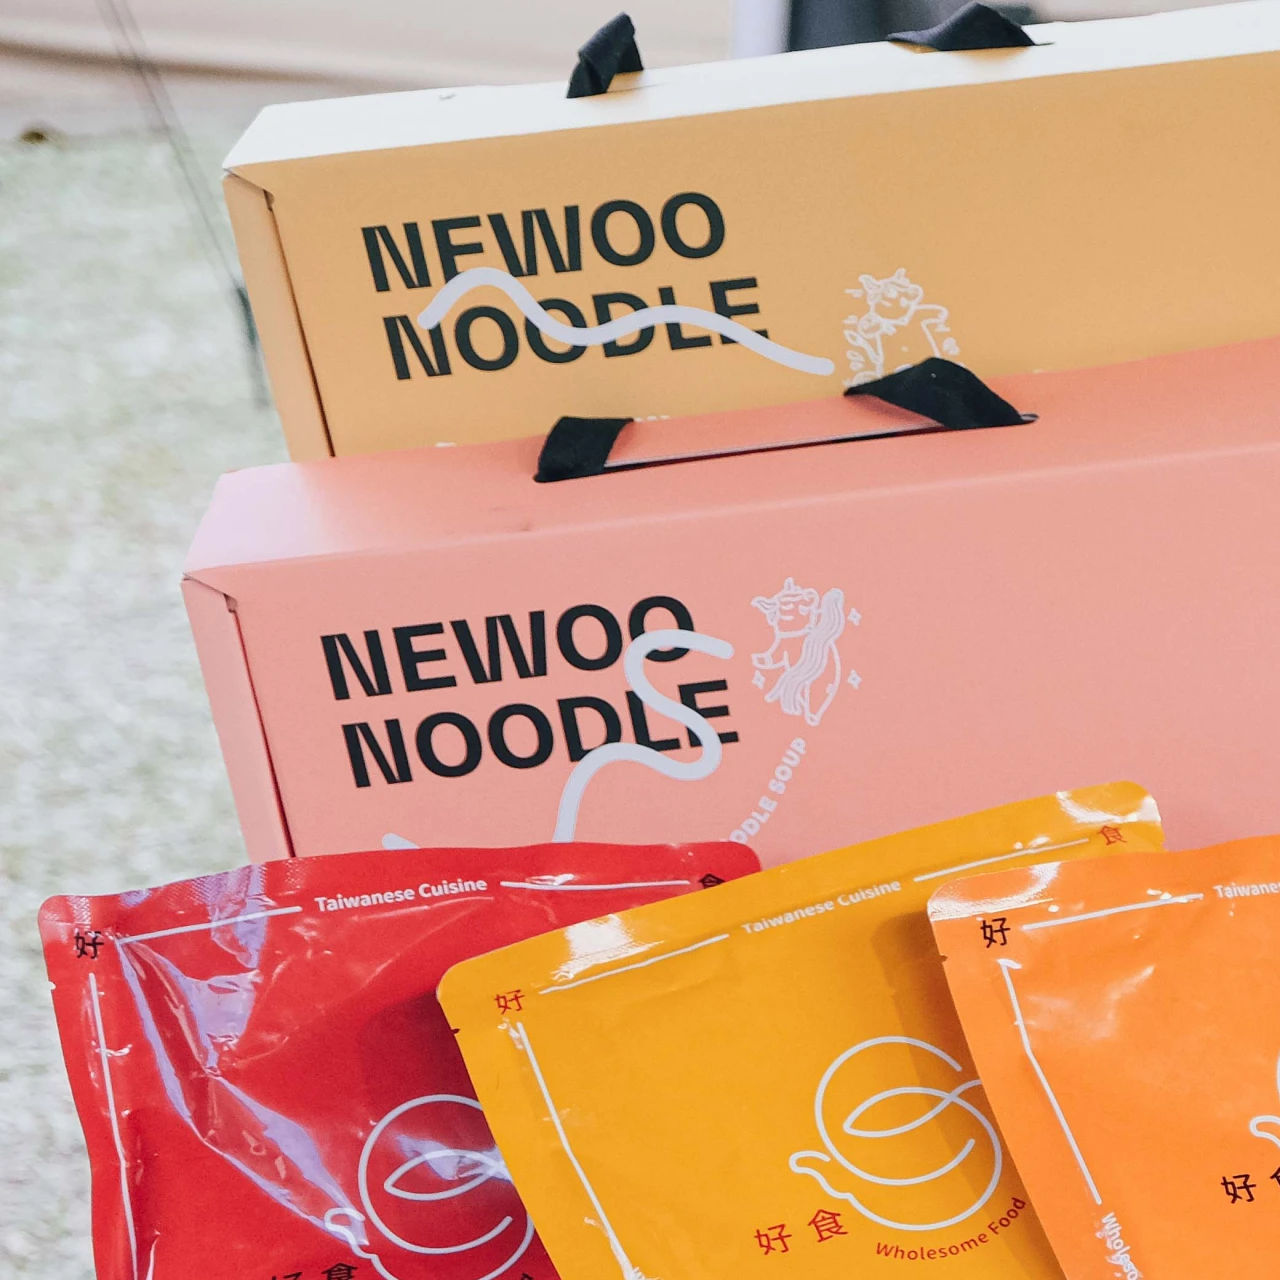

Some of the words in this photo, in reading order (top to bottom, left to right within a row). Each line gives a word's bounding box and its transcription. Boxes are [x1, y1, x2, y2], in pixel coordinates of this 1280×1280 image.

[361, 191, 725, 293] NEWOO
[383, 277, 768, 381] NOODLE
[320, 595, 695, 701] NEWOO
[341, 679, 739, 788] NOODLE
[768, 738, 806, 795] SOUP
[1099, 824, 1129, 847] 食
[314, 887, 416, 913] Taiwanese
[418, 878, 488, 899] Cuisine
[741, 899, 836, 935] Taiwanese
[837, 880, 902, 907] Cuisine
[75, 929, 105, 961] 好
[980, 917, 1012, 949] 好
[494, 988, 527, 1015] 好
[876, 1231, 990, 1261] Wholesome
[987, 1196, 1027, 1235] Food
